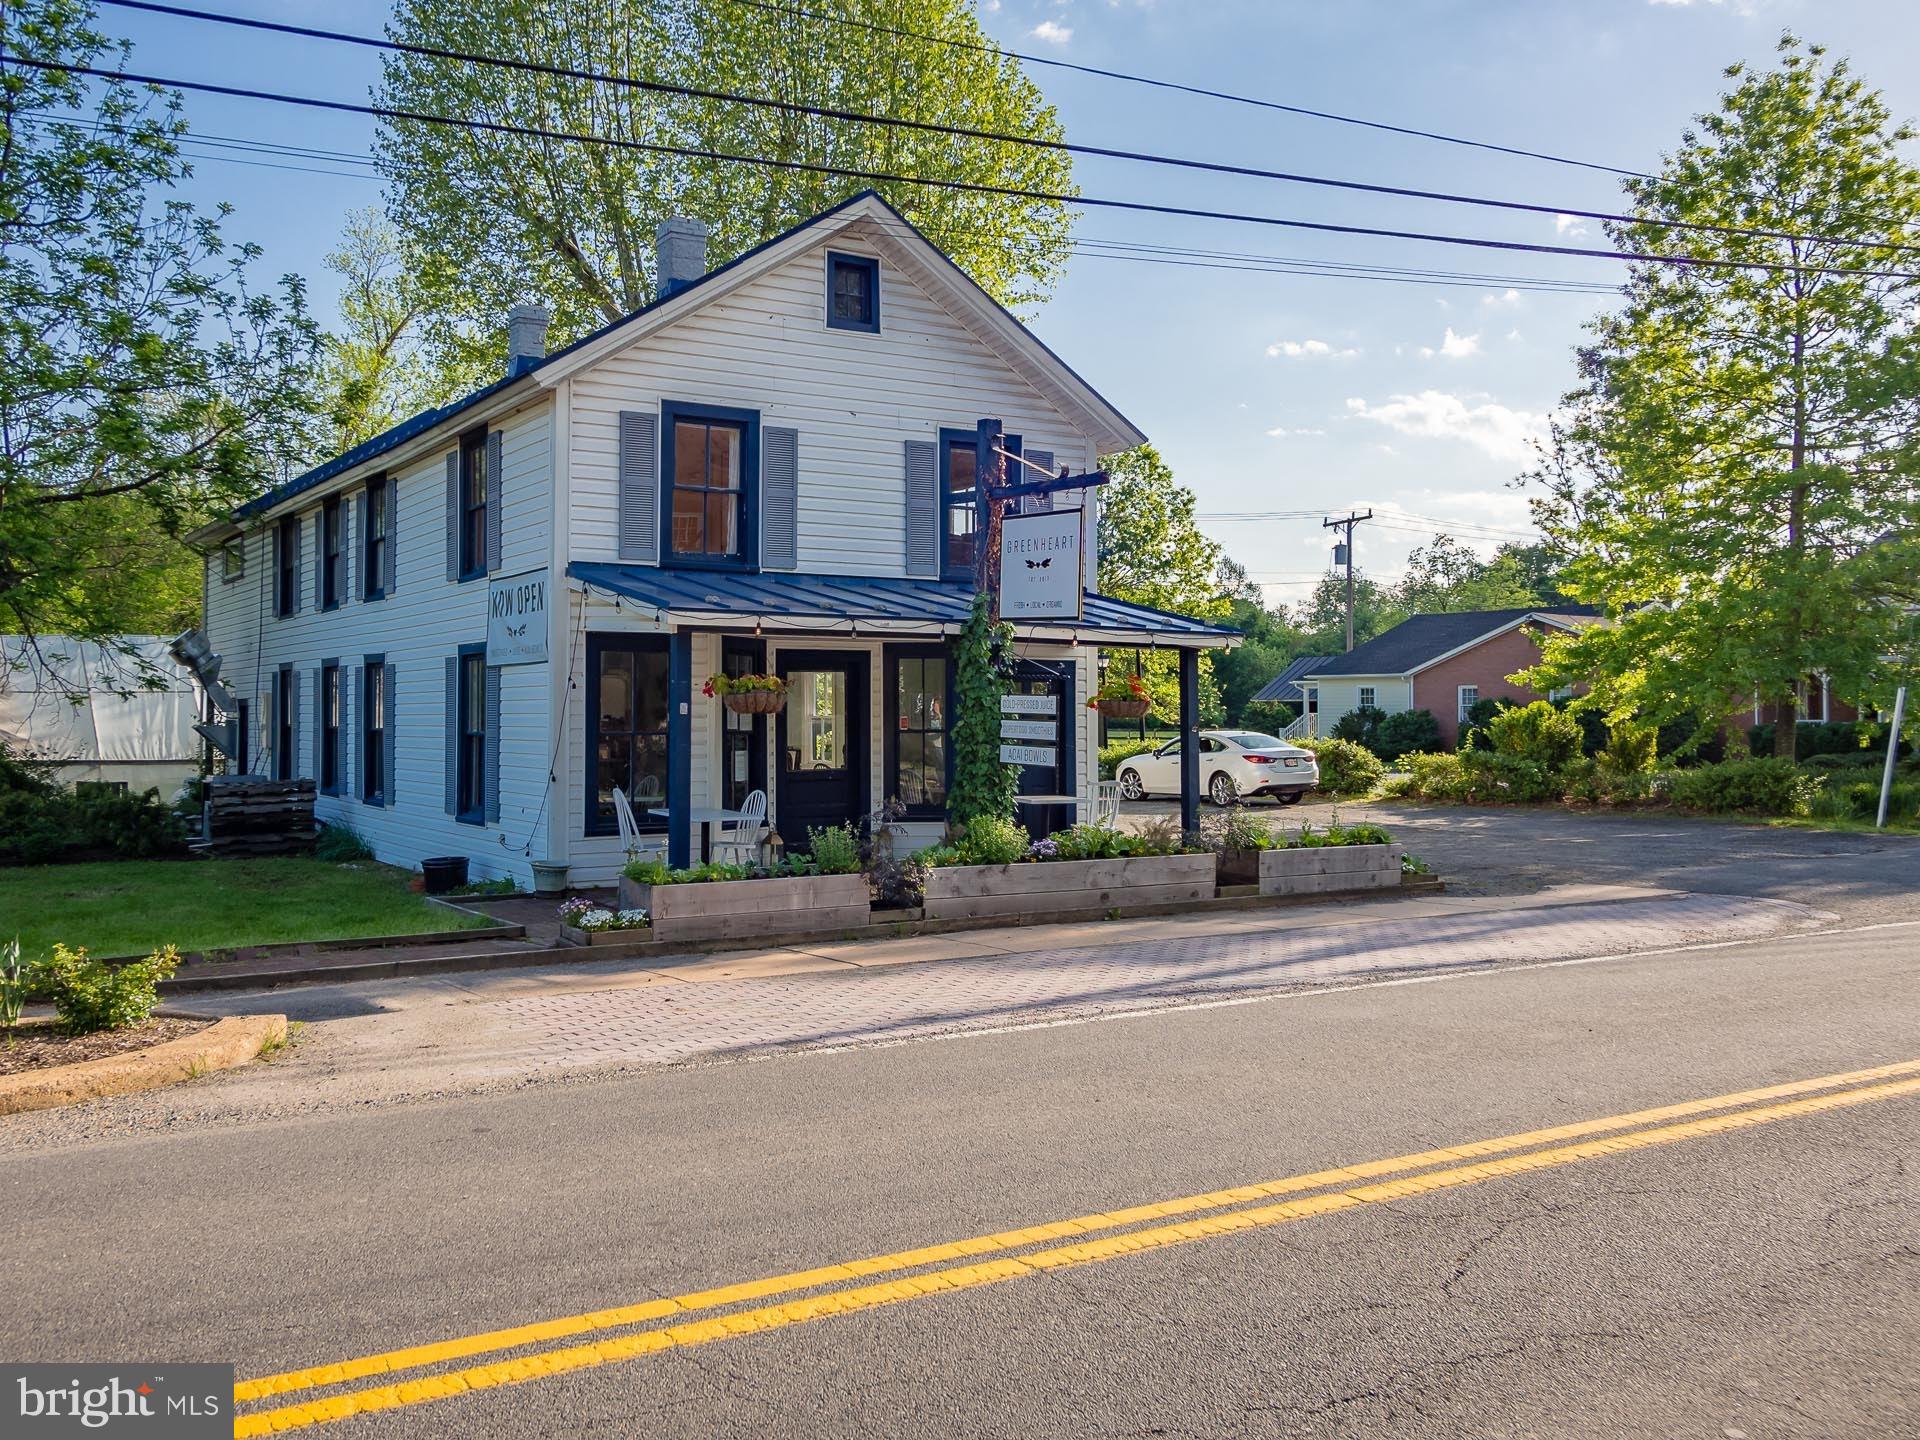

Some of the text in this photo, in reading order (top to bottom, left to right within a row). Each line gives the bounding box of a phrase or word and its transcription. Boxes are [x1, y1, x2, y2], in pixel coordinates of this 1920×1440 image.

[1007, 536, 1073, 553] GREENHEART
[517, 581, 545, 616] OPEN
[1025, 749, 1048, 763] BOWLS
